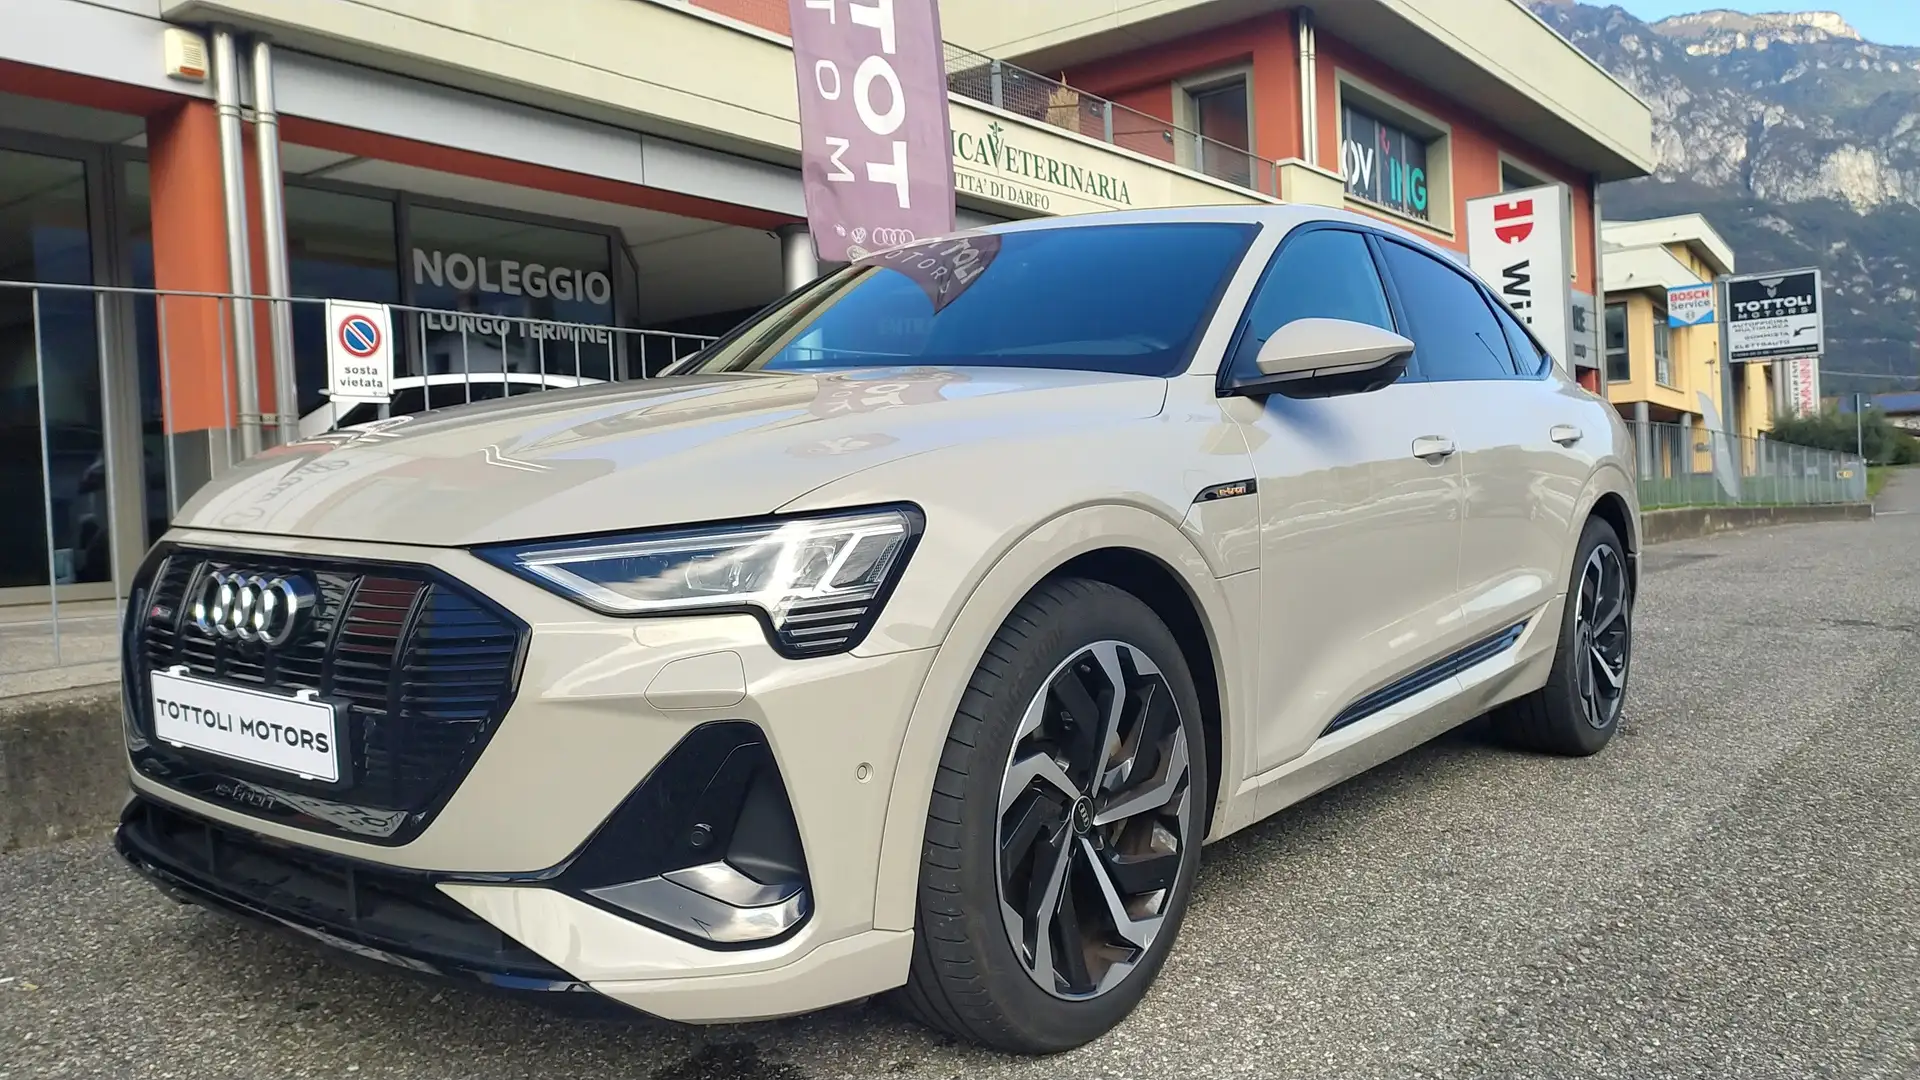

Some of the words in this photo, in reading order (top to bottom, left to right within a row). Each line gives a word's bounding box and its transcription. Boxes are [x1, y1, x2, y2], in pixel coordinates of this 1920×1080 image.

[986, 132, 1132, 206] VETERINARIA
[990, 181, 1005, 200] DI
[1008, 186, 1050, 211] DARFO
[412, 248, 611, 305] NOLEGGIO
[1670, 290, 1710, 302] BOSCH
[1670, 299, 1711, 311] Service
[1734, 294, 1812, 313] TOTTOLI
[1737, 306, 1809, 320] MOTORS
[426, 312, 510, 336] LUNGO
[518, 317, 608, 344] TERMINE
[344, 365, 378, 375] sosta
[340, 377, 383, 388] vietata
[157, 698, 232, 733] TOTTOLI
[239, 716, 329, 753] MOTORS
